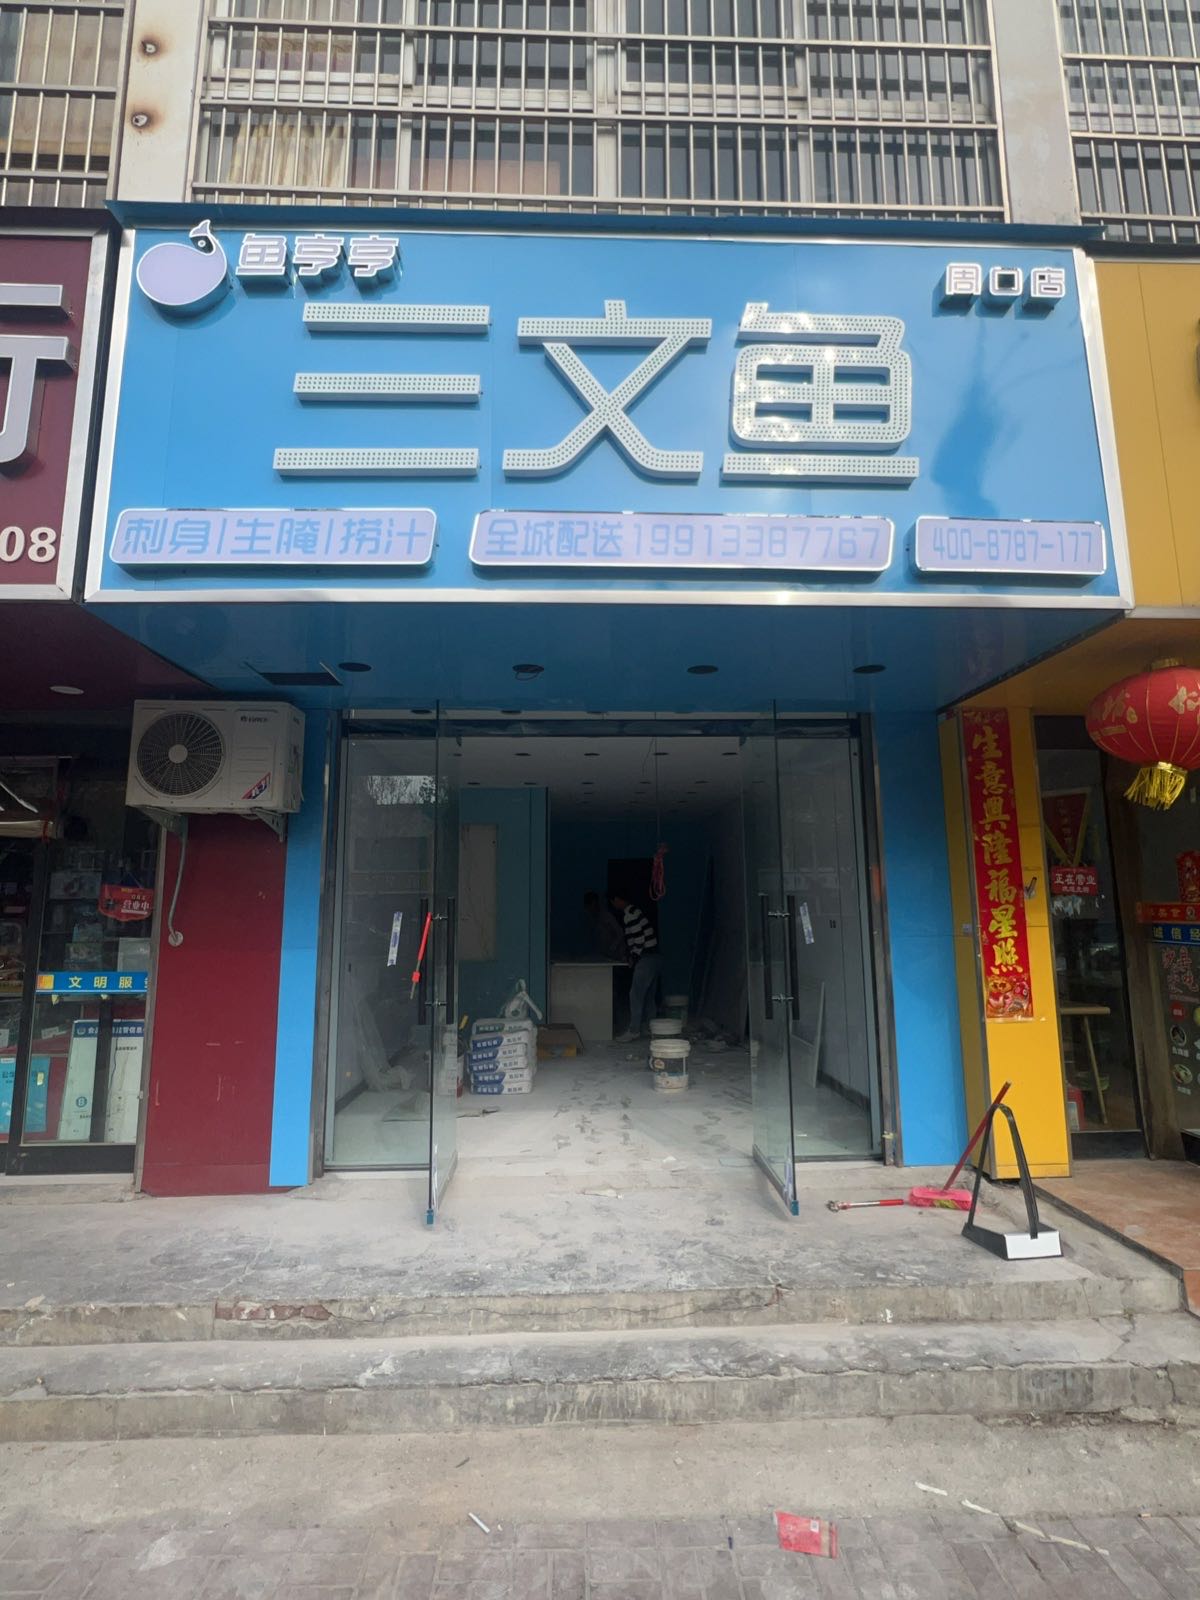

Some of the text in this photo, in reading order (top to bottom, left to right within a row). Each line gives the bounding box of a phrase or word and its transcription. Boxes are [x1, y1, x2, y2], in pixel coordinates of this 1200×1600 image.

[235, 232, 399, 278] 鱼亨亨
[945, 262, 1066, 299] 周口店
[272, 298, 920, 484] 三文鱼
[932, 527, 1093, 564] 400-8787-177
[1053, 873, 1097, 886] 正在营业
[68, 975, 148, 989] 文明服
